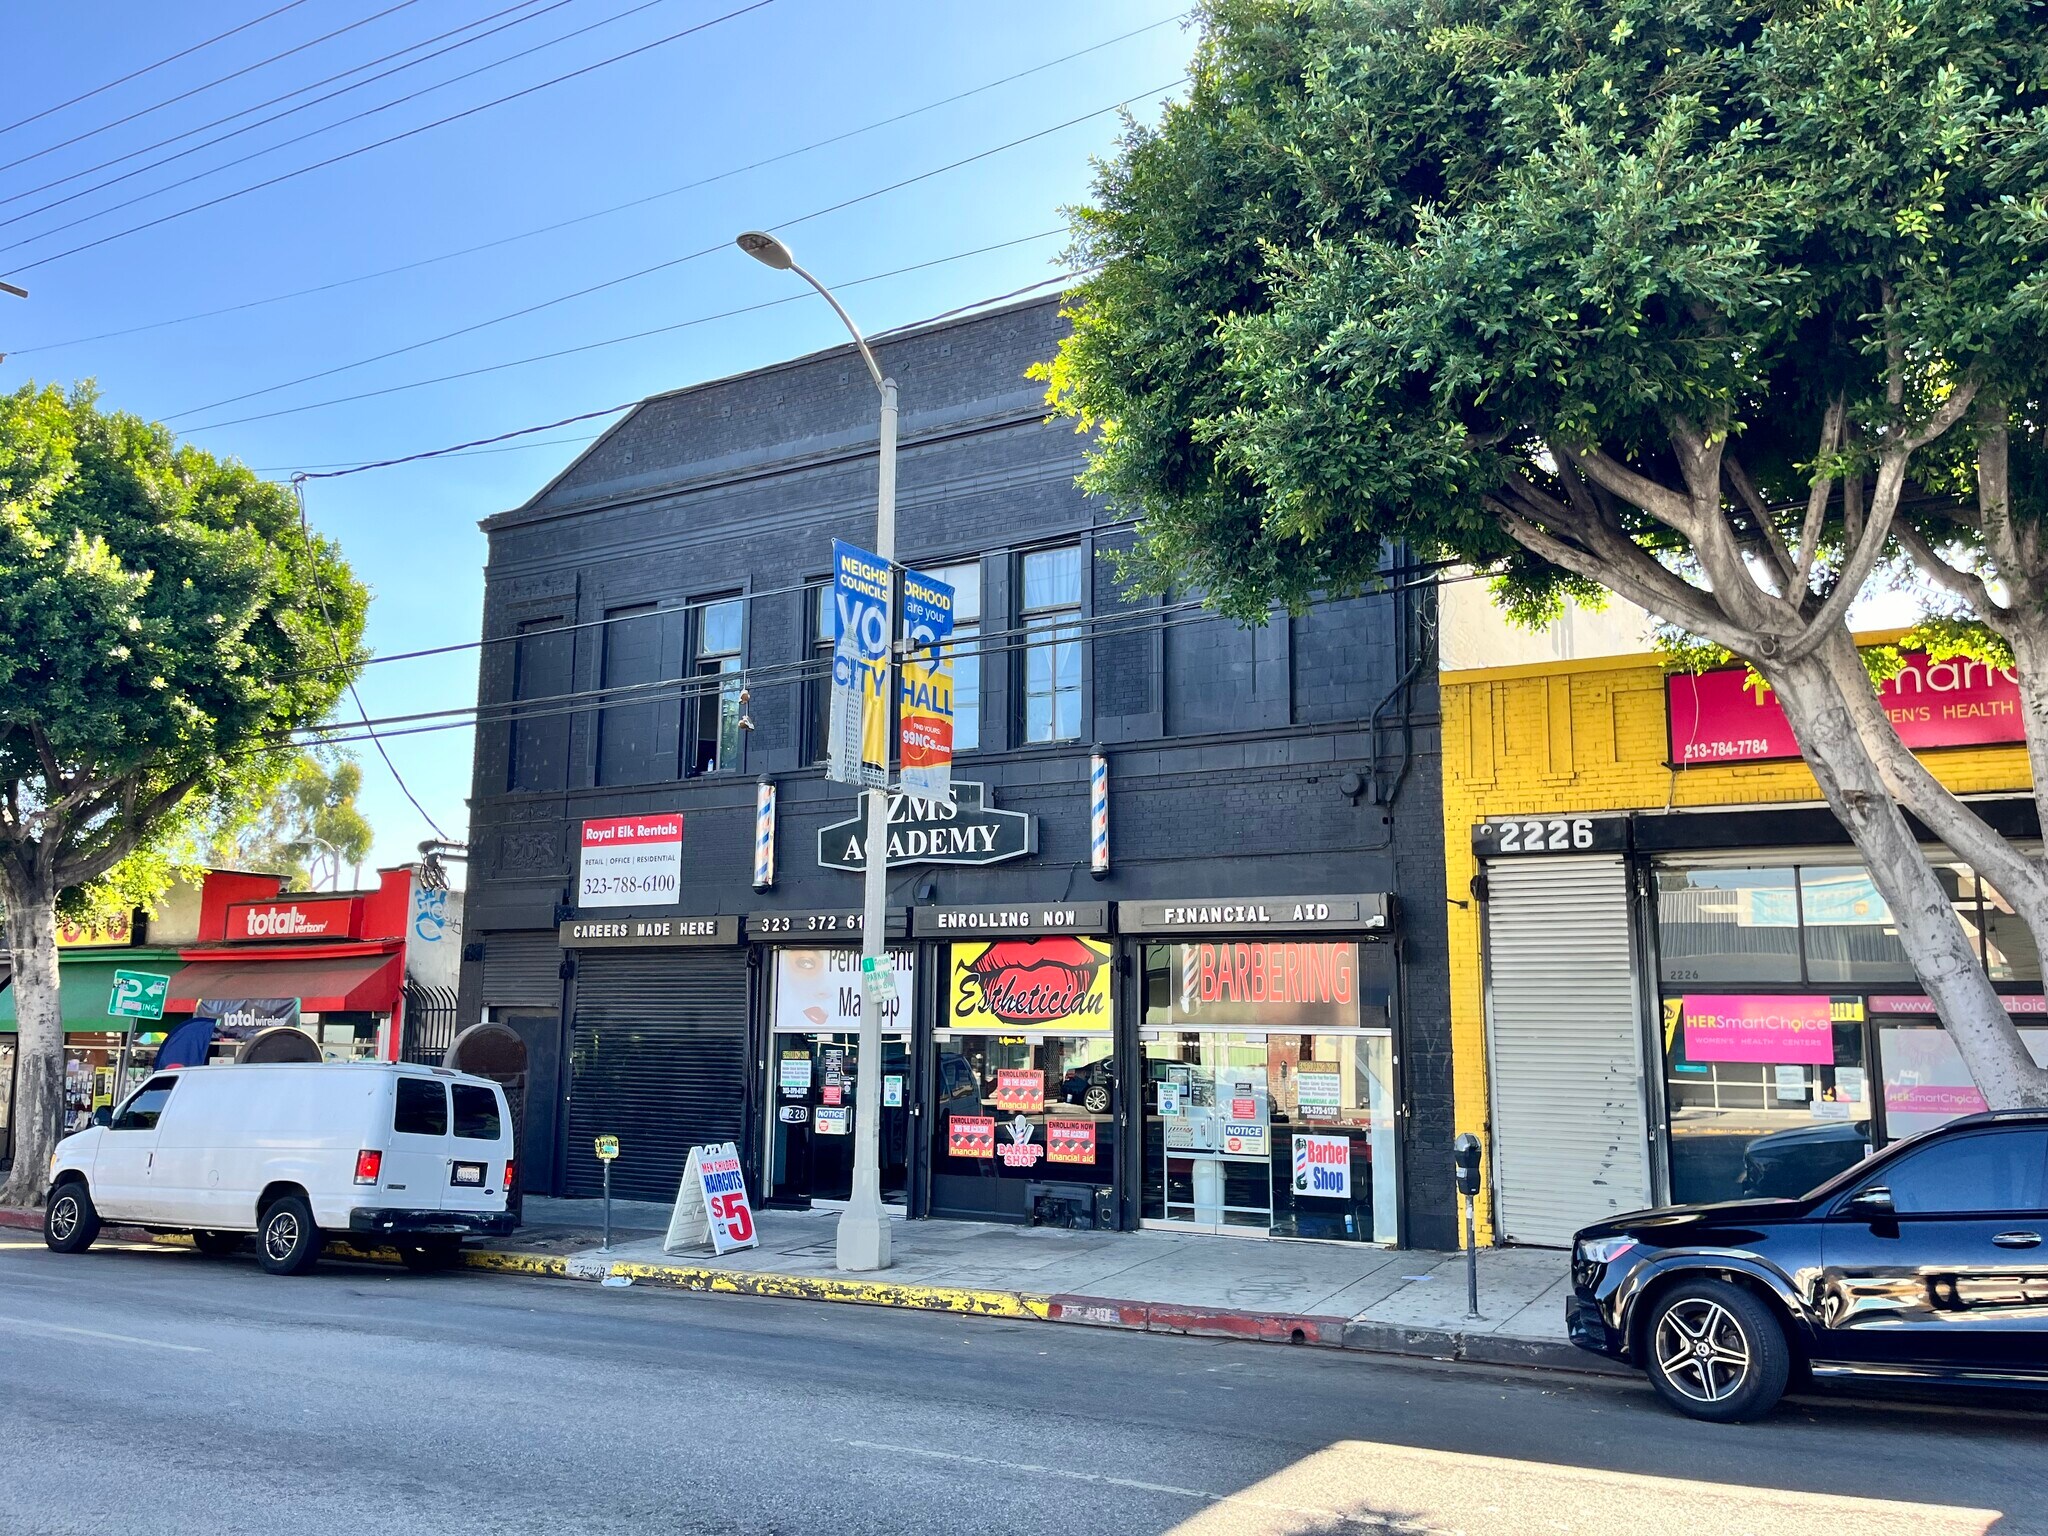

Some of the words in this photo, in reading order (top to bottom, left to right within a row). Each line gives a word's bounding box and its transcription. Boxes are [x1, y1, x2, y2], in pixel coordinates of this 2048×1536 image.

[842, 556, 887, 586] NEIGHB
[840, 575, 888, 601] COUNCILS
[904, 580, 950, 610] ORHOOD
[908, 602, 923, 615] are
[925, 608, 946, 624] your
[832, 656, 886, 697] CITY
[901, 677, 953, 716] HALL
[1943, 701, 2014, 719] HEALTH
[902, 730, 950, 753] 99NCs.com
[1684, 739, 1768, 758] 213-784-7784
[887, 789, 958, 824] ZMS
[586, 826, 614, 842] Royal
[618, 825, 634, 837] Elk
[637, 822, 677, 837] Rentals
[1500, 819, 1593, 852] 2226
[843, 825, 1000, 860] AADEMY
[586, 858, 604, 866] RETAIL
[636, 854, 675, 863] RESIDENTIAL
[584, 874, 674, 894] 323-788-6100
[247, 906, 297, 935] total
[296, 913, 306, 924] by
[938, 912, 1029, 928] ENROLLING
[1044, 911, 1076, 926] NOW
[1164, 906, 1270, 924] FINANCIAL
[1292, 904, 1330, 921] AID
[295, 920, 328, 933] verizon
[574, 924, 628, 938] CAREERS
[637, 922, 670, 936] MADE
[680, 921, 714, 936] HERE
[762, 917, 790, 932] 323
[808, 916, 836, 930] 372
[846, 915, 864, 929] 61
[829, 950, 913, 972] Perment
[1200, 942, 1350, 1004] BARBERING
[1671, 970, 1698, 980] 2226
[955, 973, 1104, 1017] Esthetician
[838, 987, 900, 1026] Maup
[1890, 1002, 1936, 1011] www.
[2003, 998, 2046, 1012] choic
[224, 1009, 254, 1026] total
[255, 1016, 286, 1026] wireless
[1686, 1015, 1828, 1033] HERSmartChoice
[1782, 1038, 1822, 1046] CENTERS
[999, 1101, 1028, 1109] financial
[1032, 1102, 1042, 1110] aid
[1890, 1094, 1980, 1104] HERSmartChoice
[782, 1107, 804, 1119] 228
[818, 1110, 845, 1118] NOTICE
[1080, 1122, 1094, 1130] NOW
[1226, 1126, 1262, 1136] NOTICE
[950, 1147, 980, 1156] financial
[982, 1148, 992, 1156] aid
[998, 1144, 1043, 1156] BARBER
[1049, 1152, 1080, 1162] financial
[1082, 1154, 1094, 1162] aid
[1308, 1140, 1348, 1164] Barber
[702, 1163, 714, 1174] MEN
[1006, 1156, 1036, 1165] SHOP
[704, 1170, 742, 1194] HAIRCUTS
[1314, 1166, 1343, 1193] Shop
[711, 1192, 752, 1242] $5
